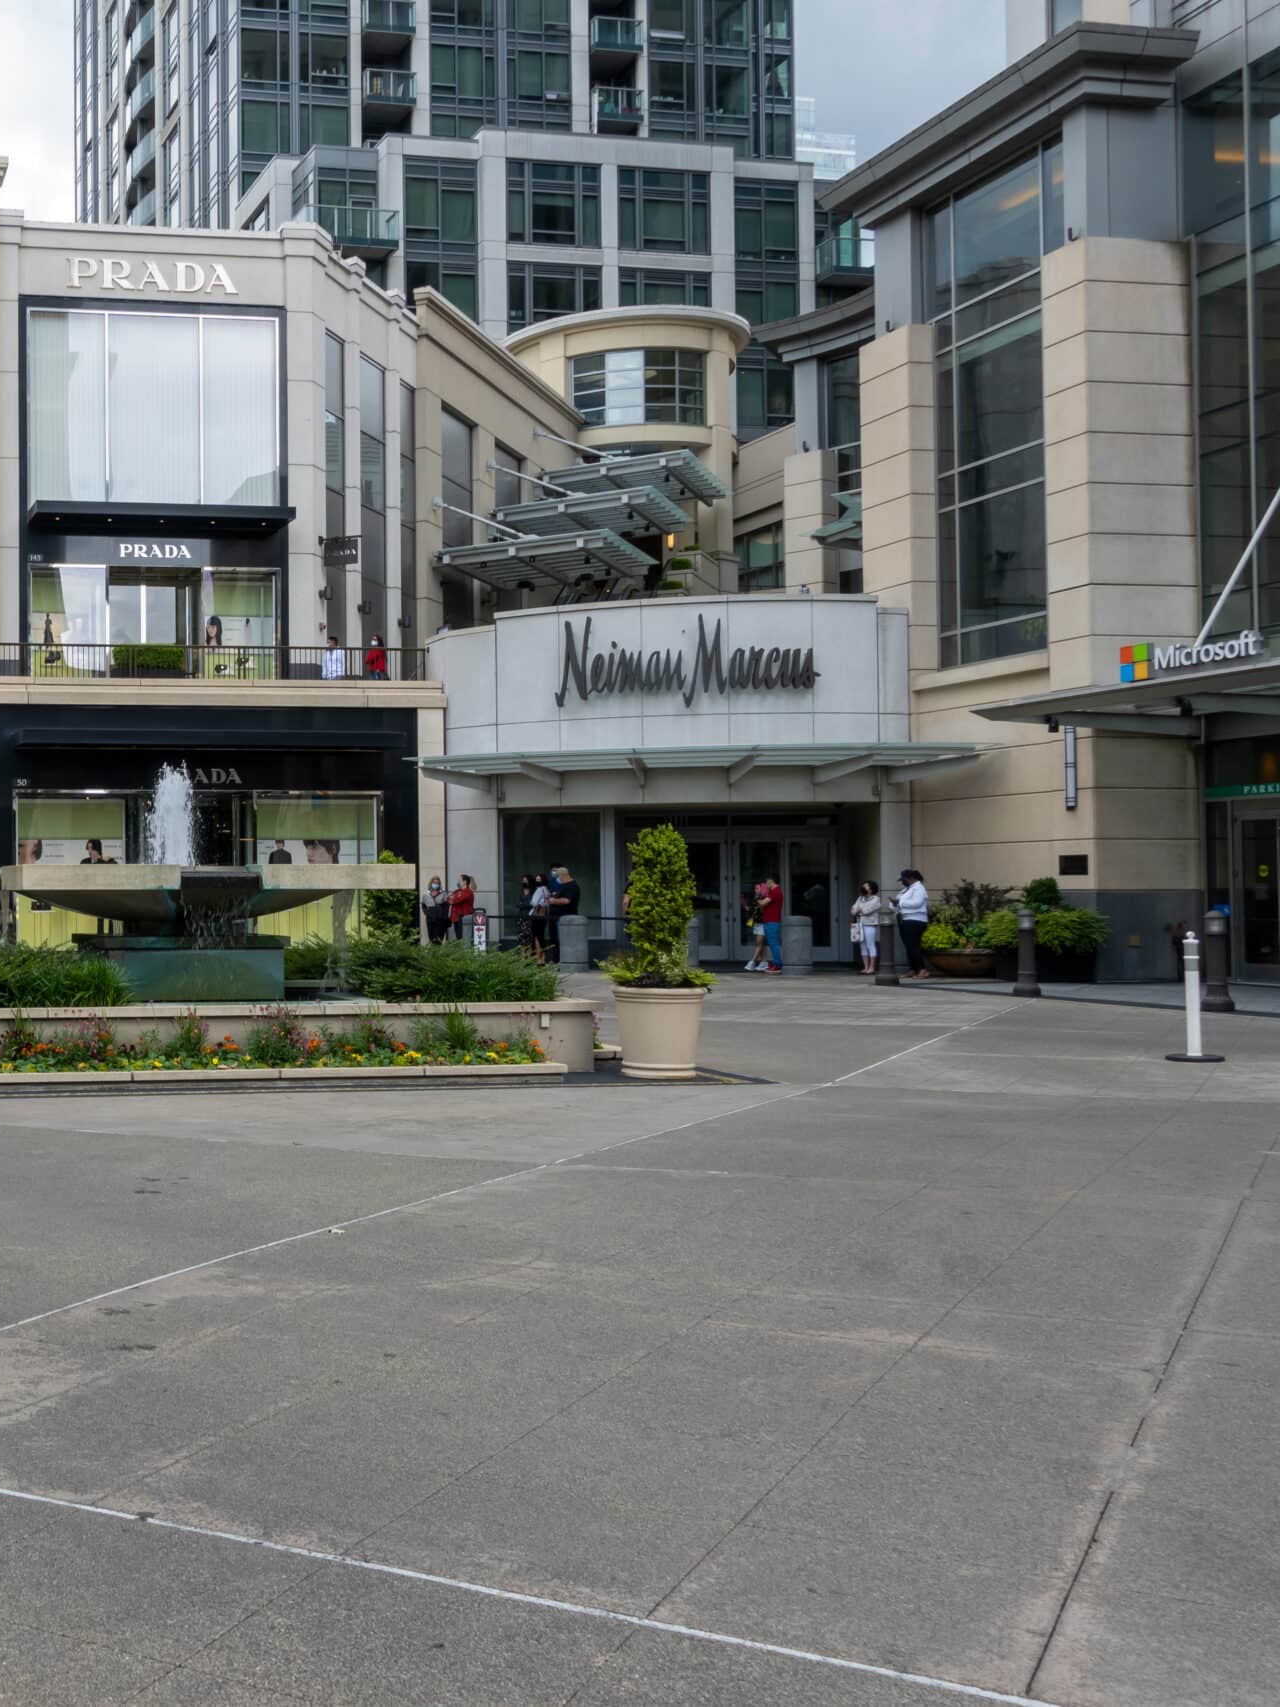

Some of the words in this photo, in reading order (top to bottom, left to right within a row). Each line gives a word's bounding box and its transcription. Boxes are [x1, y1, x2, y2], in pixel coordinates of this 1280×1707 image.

[66, 256, 239, 295] PRADA
[119, 543, 193, 559] PRADA
[554, 616, 687, 708] Neiman
[682, 613, 822, 708] Marcus
[1153, 630, 1258, 670] Microsoft
[193, 768, 242, 784] ADA
